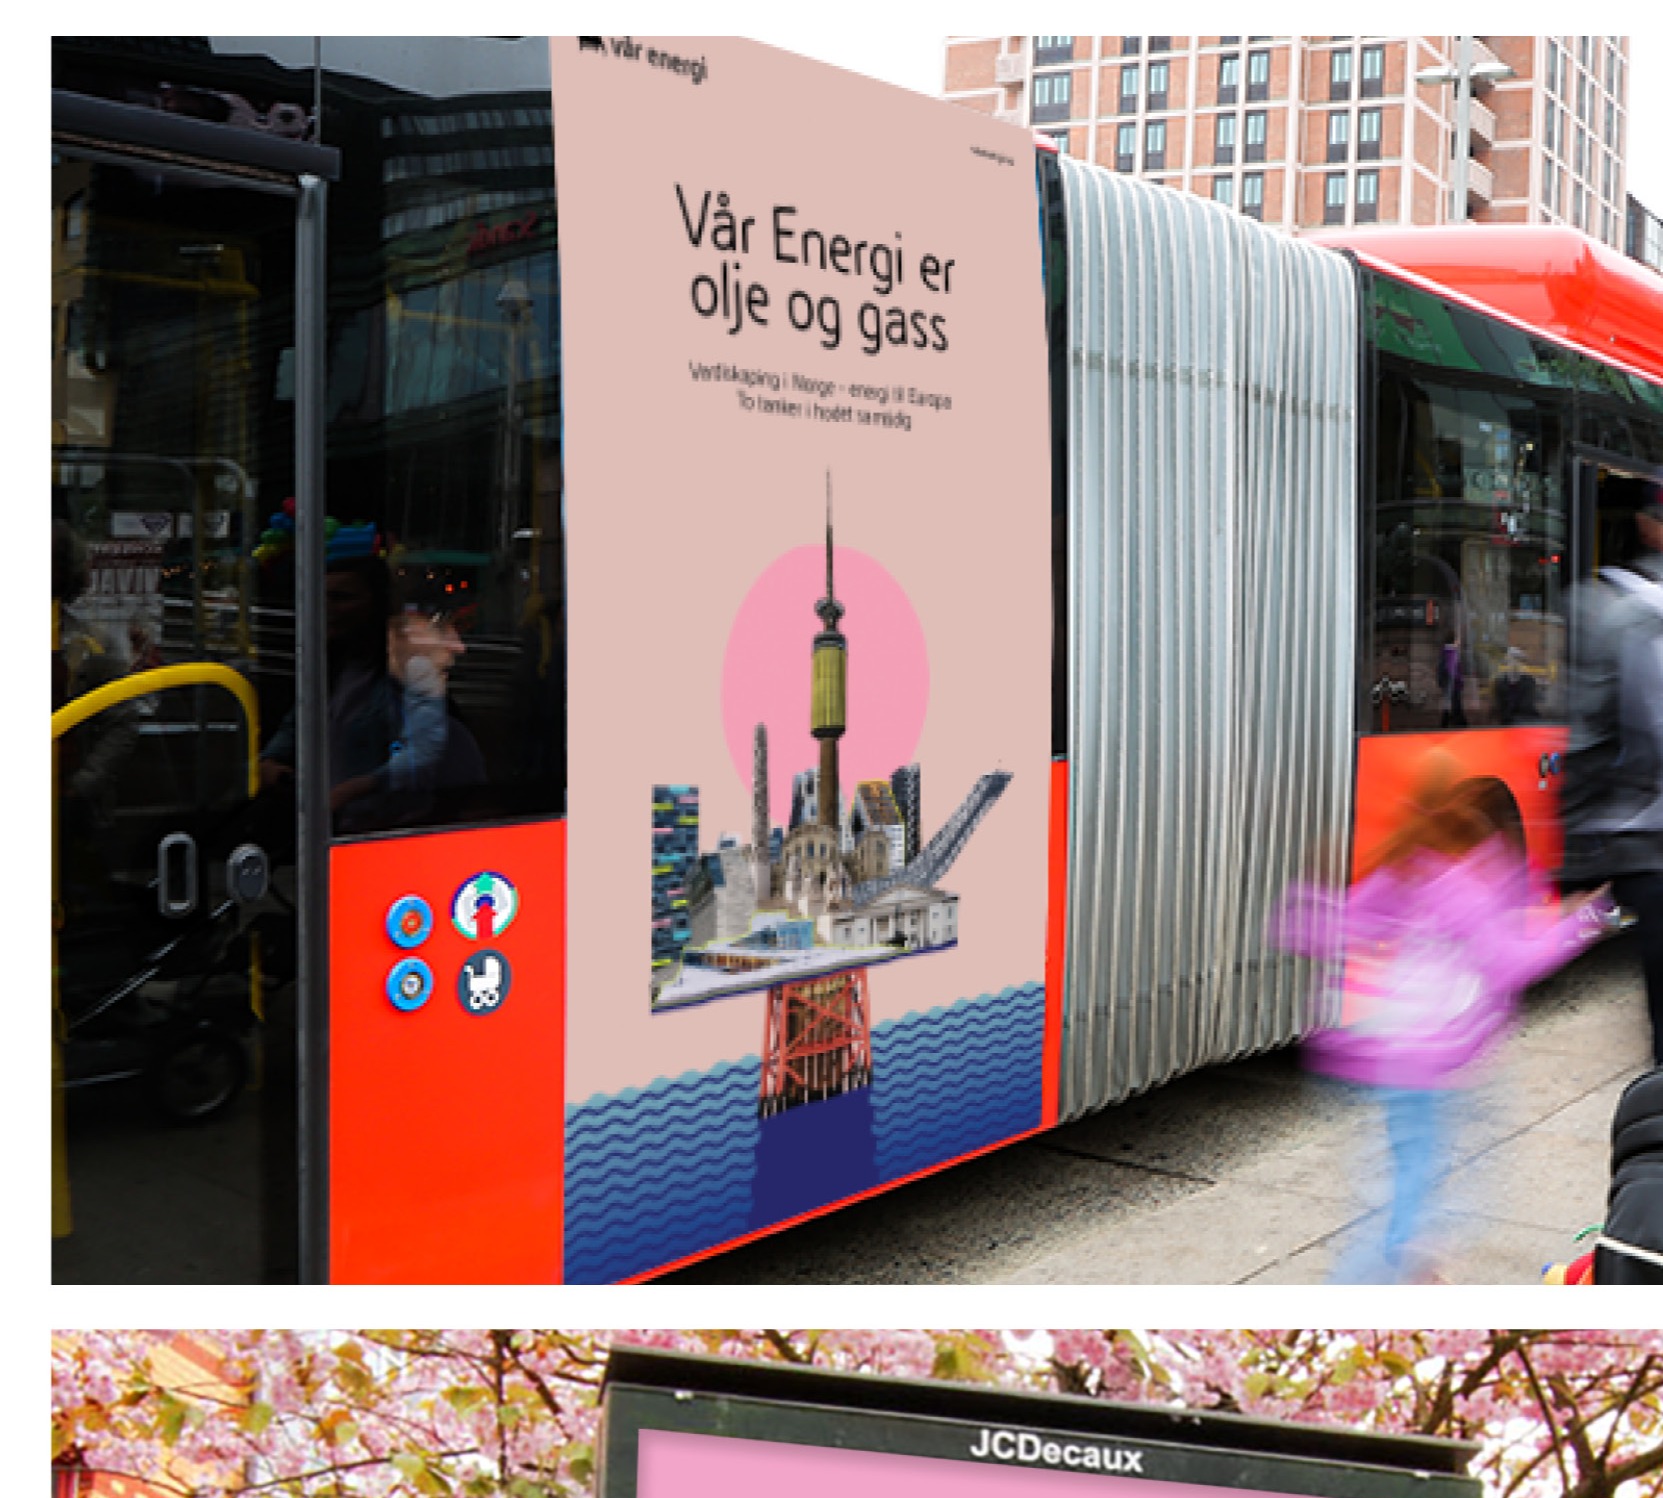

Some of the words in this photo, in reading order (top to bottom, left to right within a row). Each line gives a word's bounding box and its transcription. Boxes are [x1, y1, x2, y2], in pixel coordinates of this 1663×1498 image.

[647, 47, 708, 85] energi
[674, 183, 756, 255] Vår
[773, 205, 903, 297] Energi
[919, 252, 956, 295] er
[690, 260, 771, 336] olje
[787, 290, 843, 351] og
[857, 300, 949, 356] gass
[970, 1429, 1143, 1473] JCDecaux
